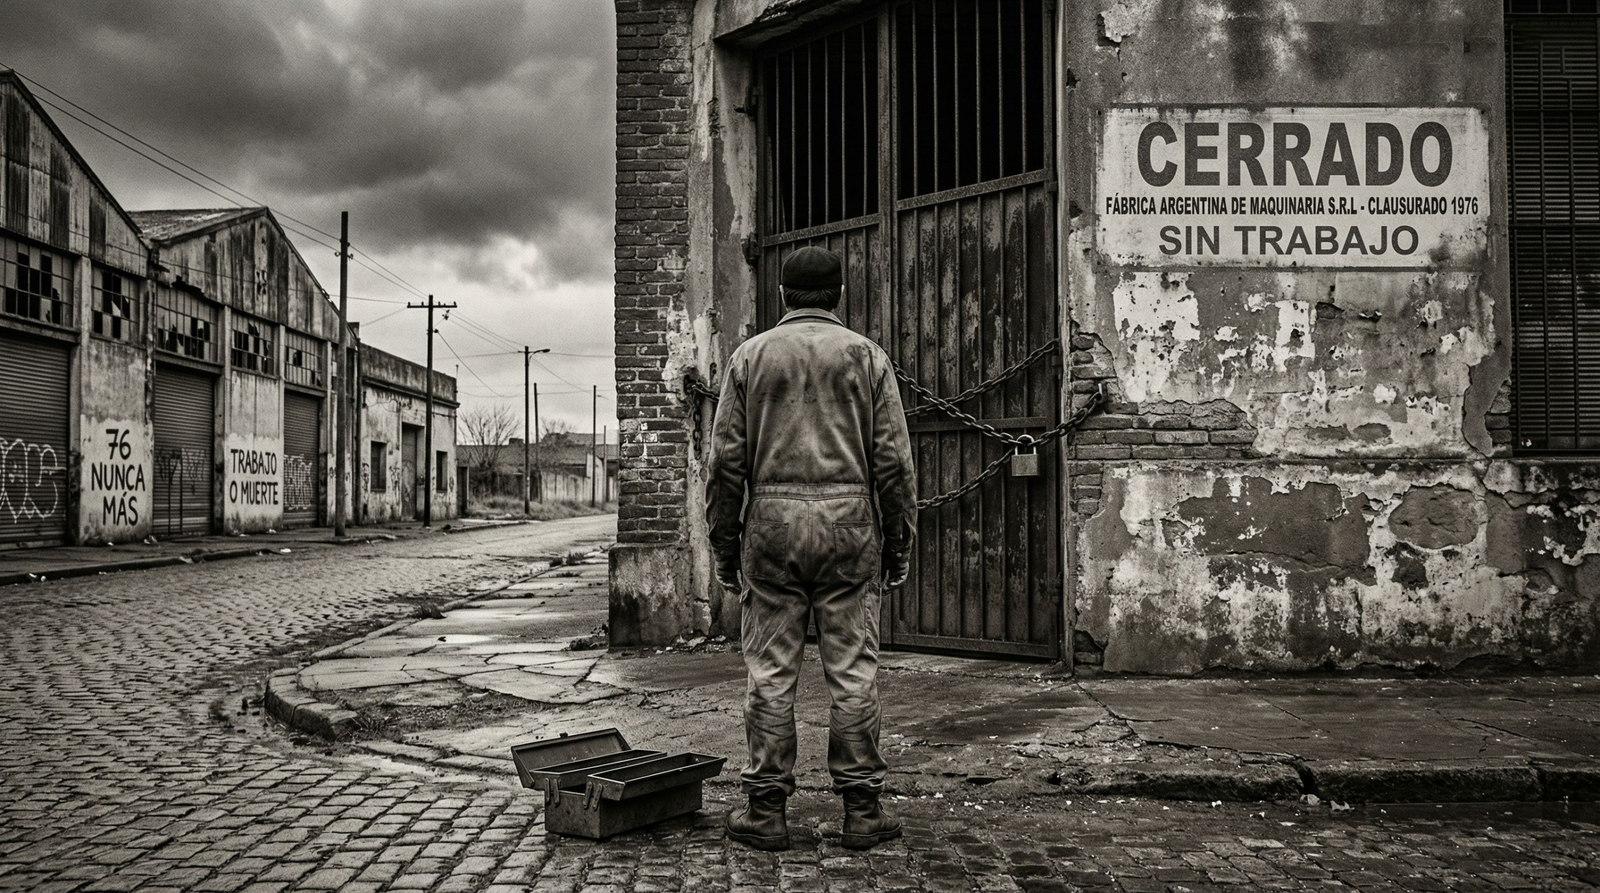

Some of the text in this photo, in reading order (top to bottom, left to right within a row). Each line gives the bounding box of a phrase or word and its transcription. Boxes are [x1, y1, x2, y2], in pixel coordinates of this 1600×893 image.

[1137, 121, 1453, 187] CERRADO
[1105, 193, 1157, 215] FÁBRICA
[1159, 196, 1228, 215] ARGENTINA
[1231, 196, 1247, 215] DE
[1250, 196, 1325, 217] MAQUINARIA
[1328, 196, 1358, 215] S.R.L
[1368, 196, 1448, 215] CLAUSURADO
[1450, 196, 1479, 215] 1976
[1158, 225, 1419, 256] SIN TRABAJO
[105, 428, 132, 460] 76
[91, 462, 146, 492] NUNCA
[230, 448, 277, 476] TRABAJO
[229, 480, 238, 503] O
[240, 480, 279, 505] MUERTE
[102, 491, 139, 527] MÁS
